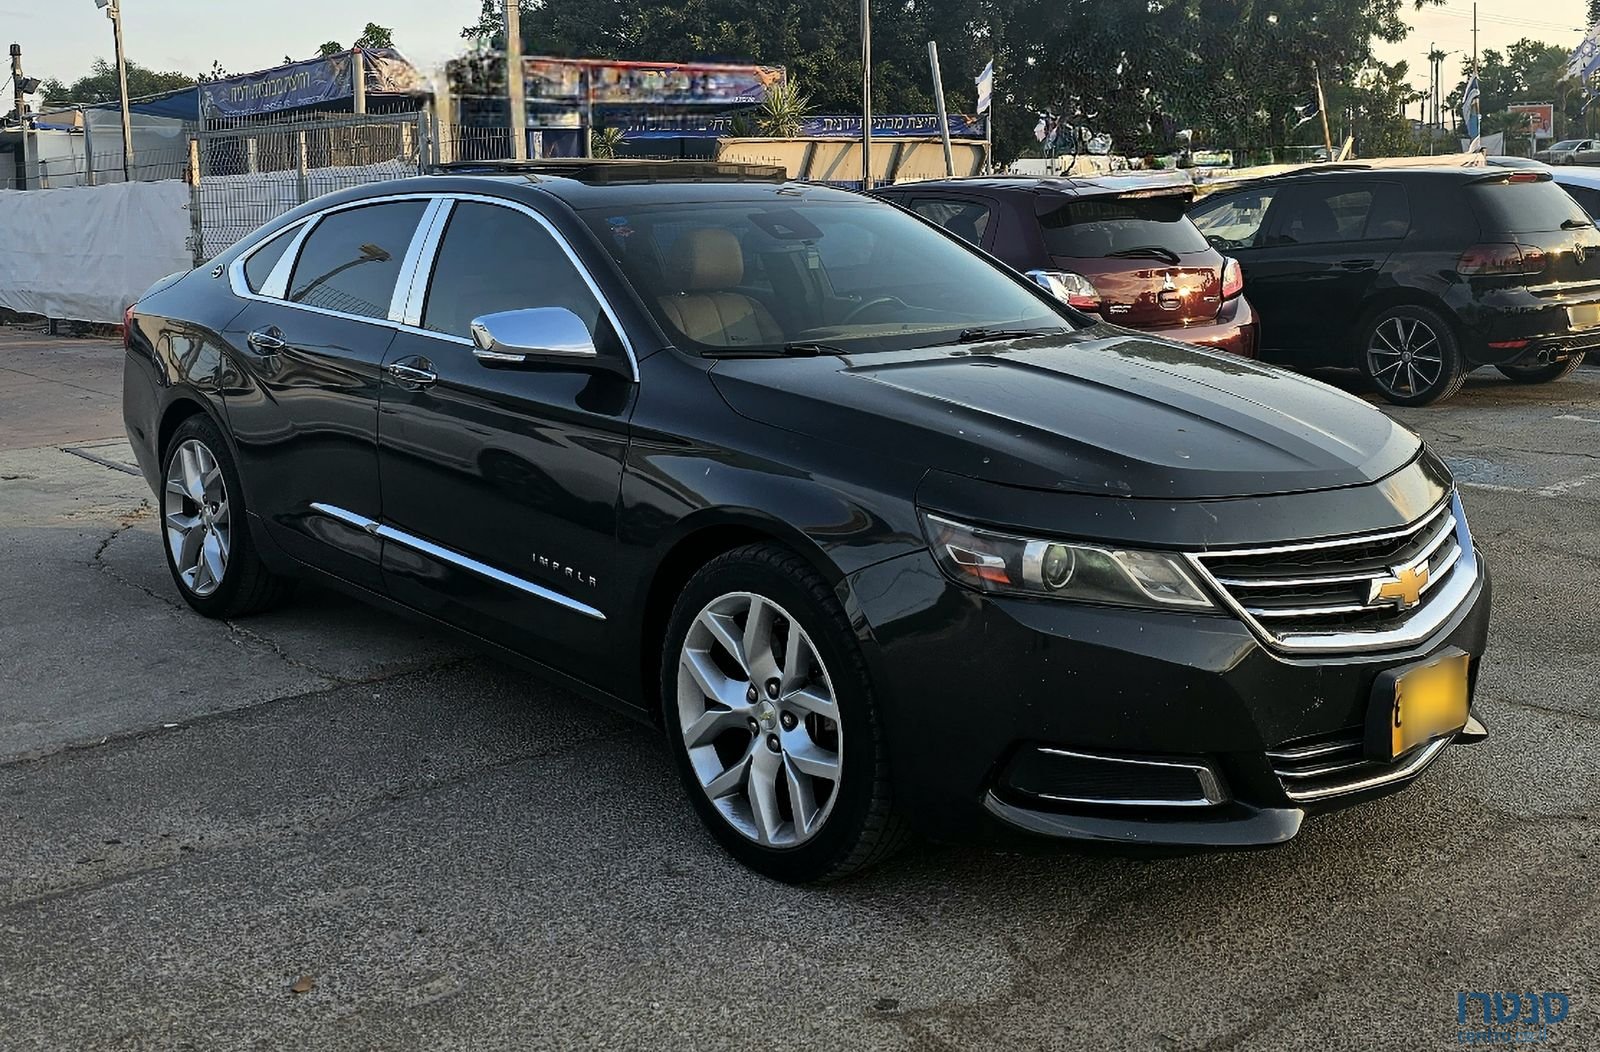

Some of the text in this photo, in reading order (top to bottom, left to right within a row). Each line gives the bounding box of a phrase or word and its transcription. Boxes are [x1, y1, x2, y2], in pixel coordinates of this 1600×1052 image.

[822, 116, 940, 131] חיצת מכונית ידנית
[532, 553, 597, 588] IMPALA
